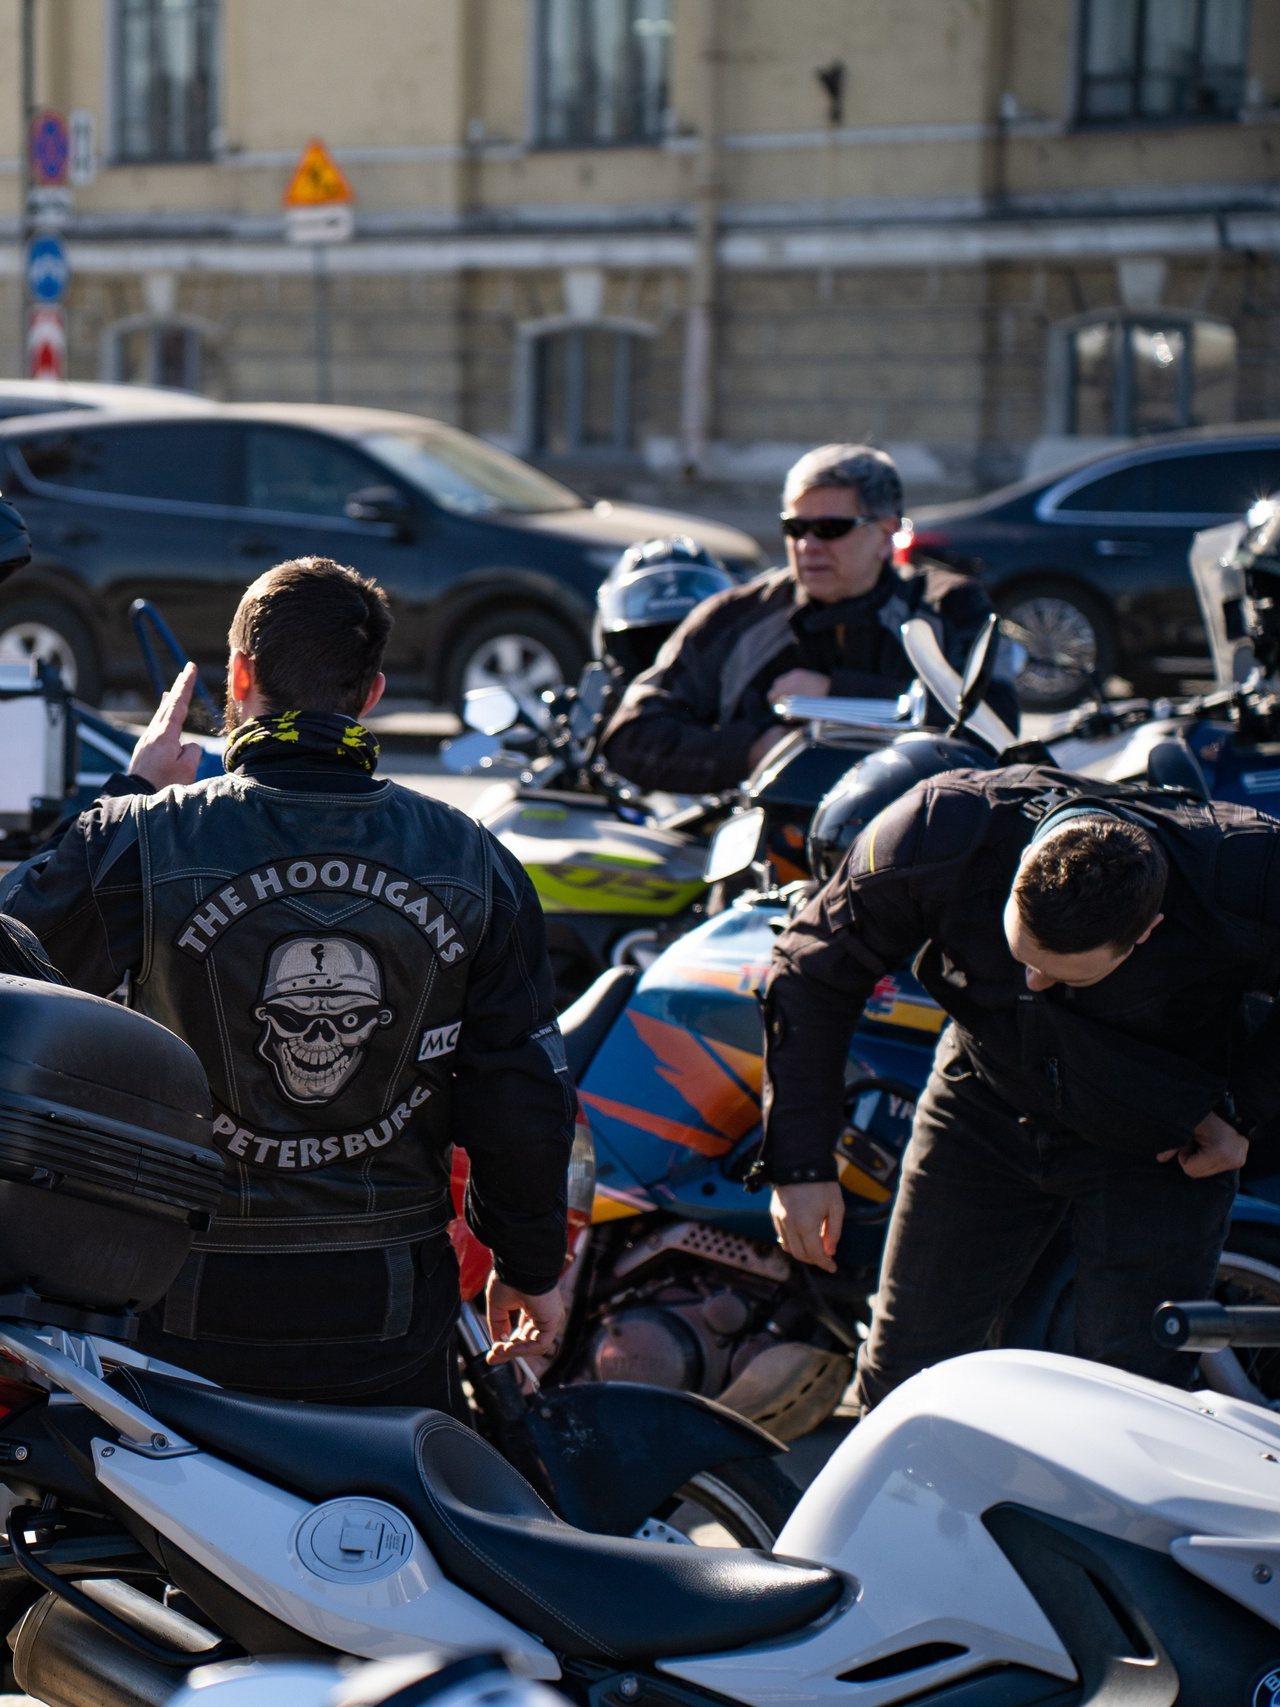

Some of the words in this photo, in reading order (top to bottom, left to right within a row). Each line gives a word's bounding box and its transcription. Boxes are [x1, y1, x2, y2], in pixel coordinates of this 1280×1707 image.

[177, 886, 248, 953] THE
[249, 860, 465, 963] HOOLIGANS
[421, 1026, 458, 1057] MC
[213, 1085, 432, 1169] PETERSBURG
